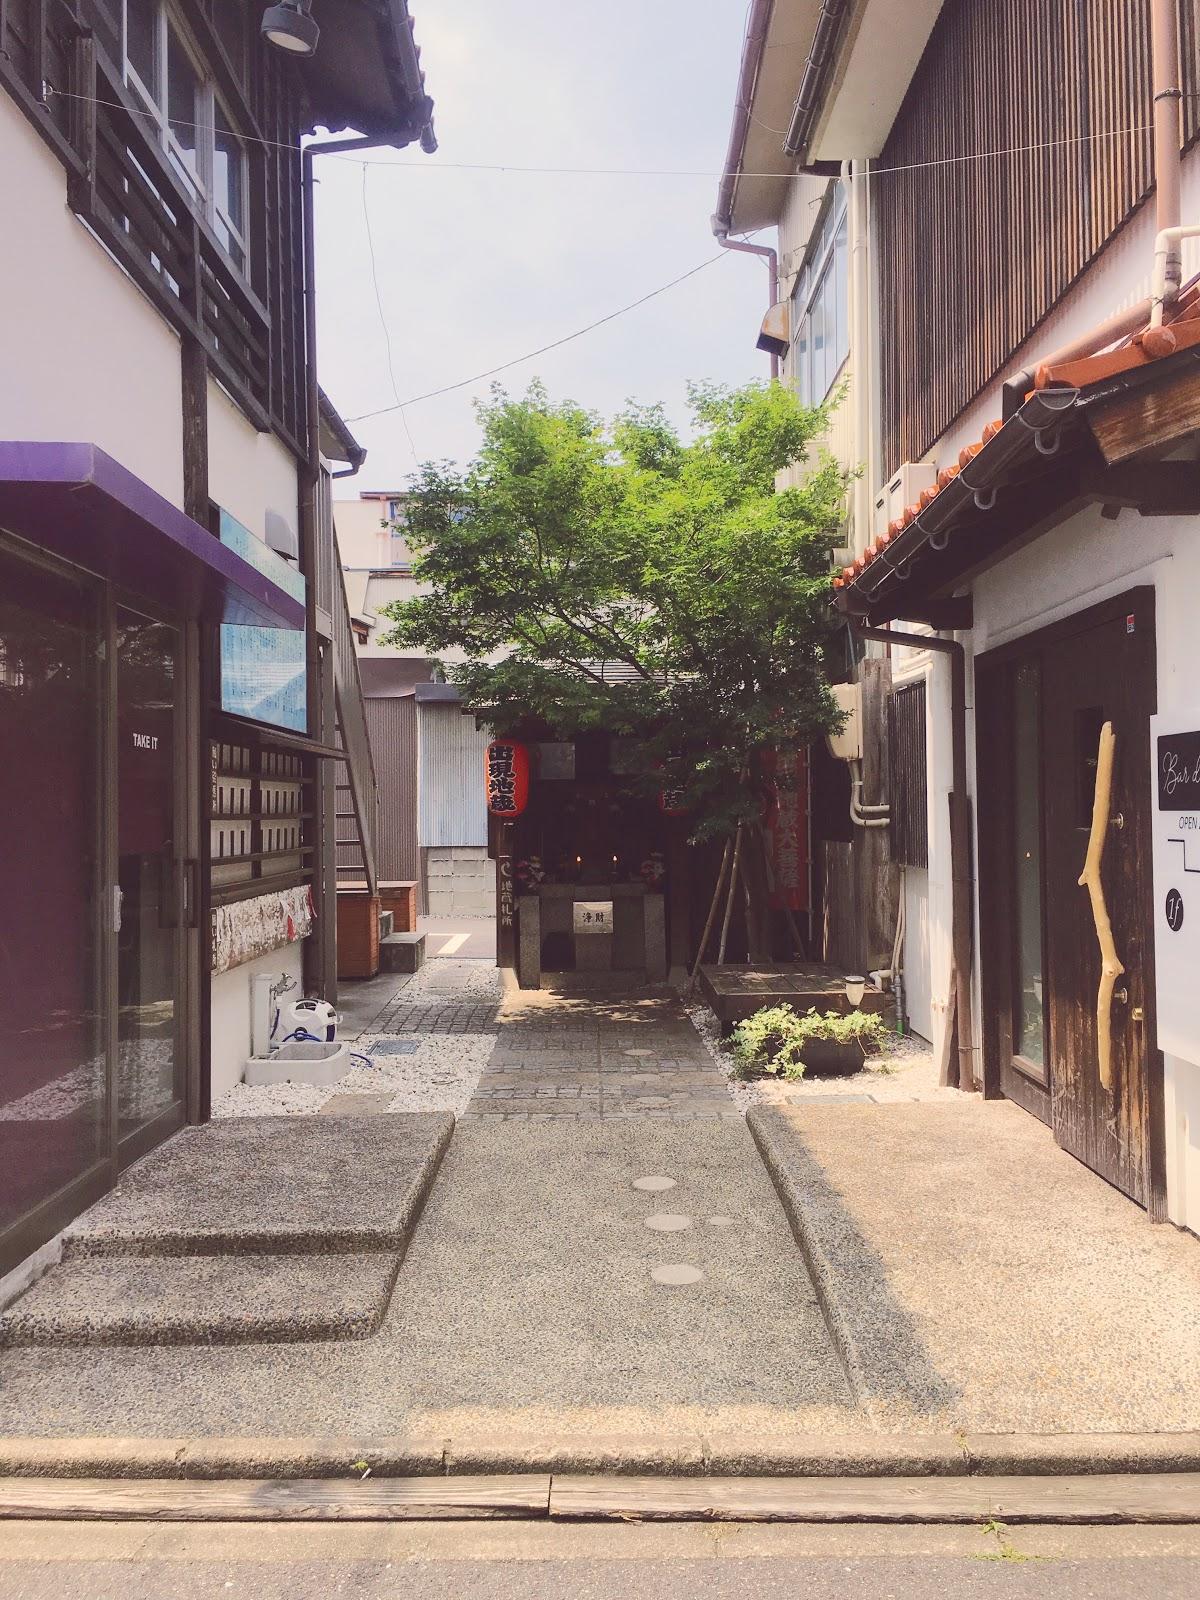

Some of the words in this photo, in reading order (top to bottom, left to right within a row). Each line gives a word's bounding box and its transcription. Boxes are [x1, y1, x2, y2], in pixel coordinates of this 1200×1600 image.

[133, 733, 150, 748] TAKE
[151, 737, 158, 749] IT
[1163, 752, 1189, 794] Bar
[1179, 816, 1197, 829] OPEN
